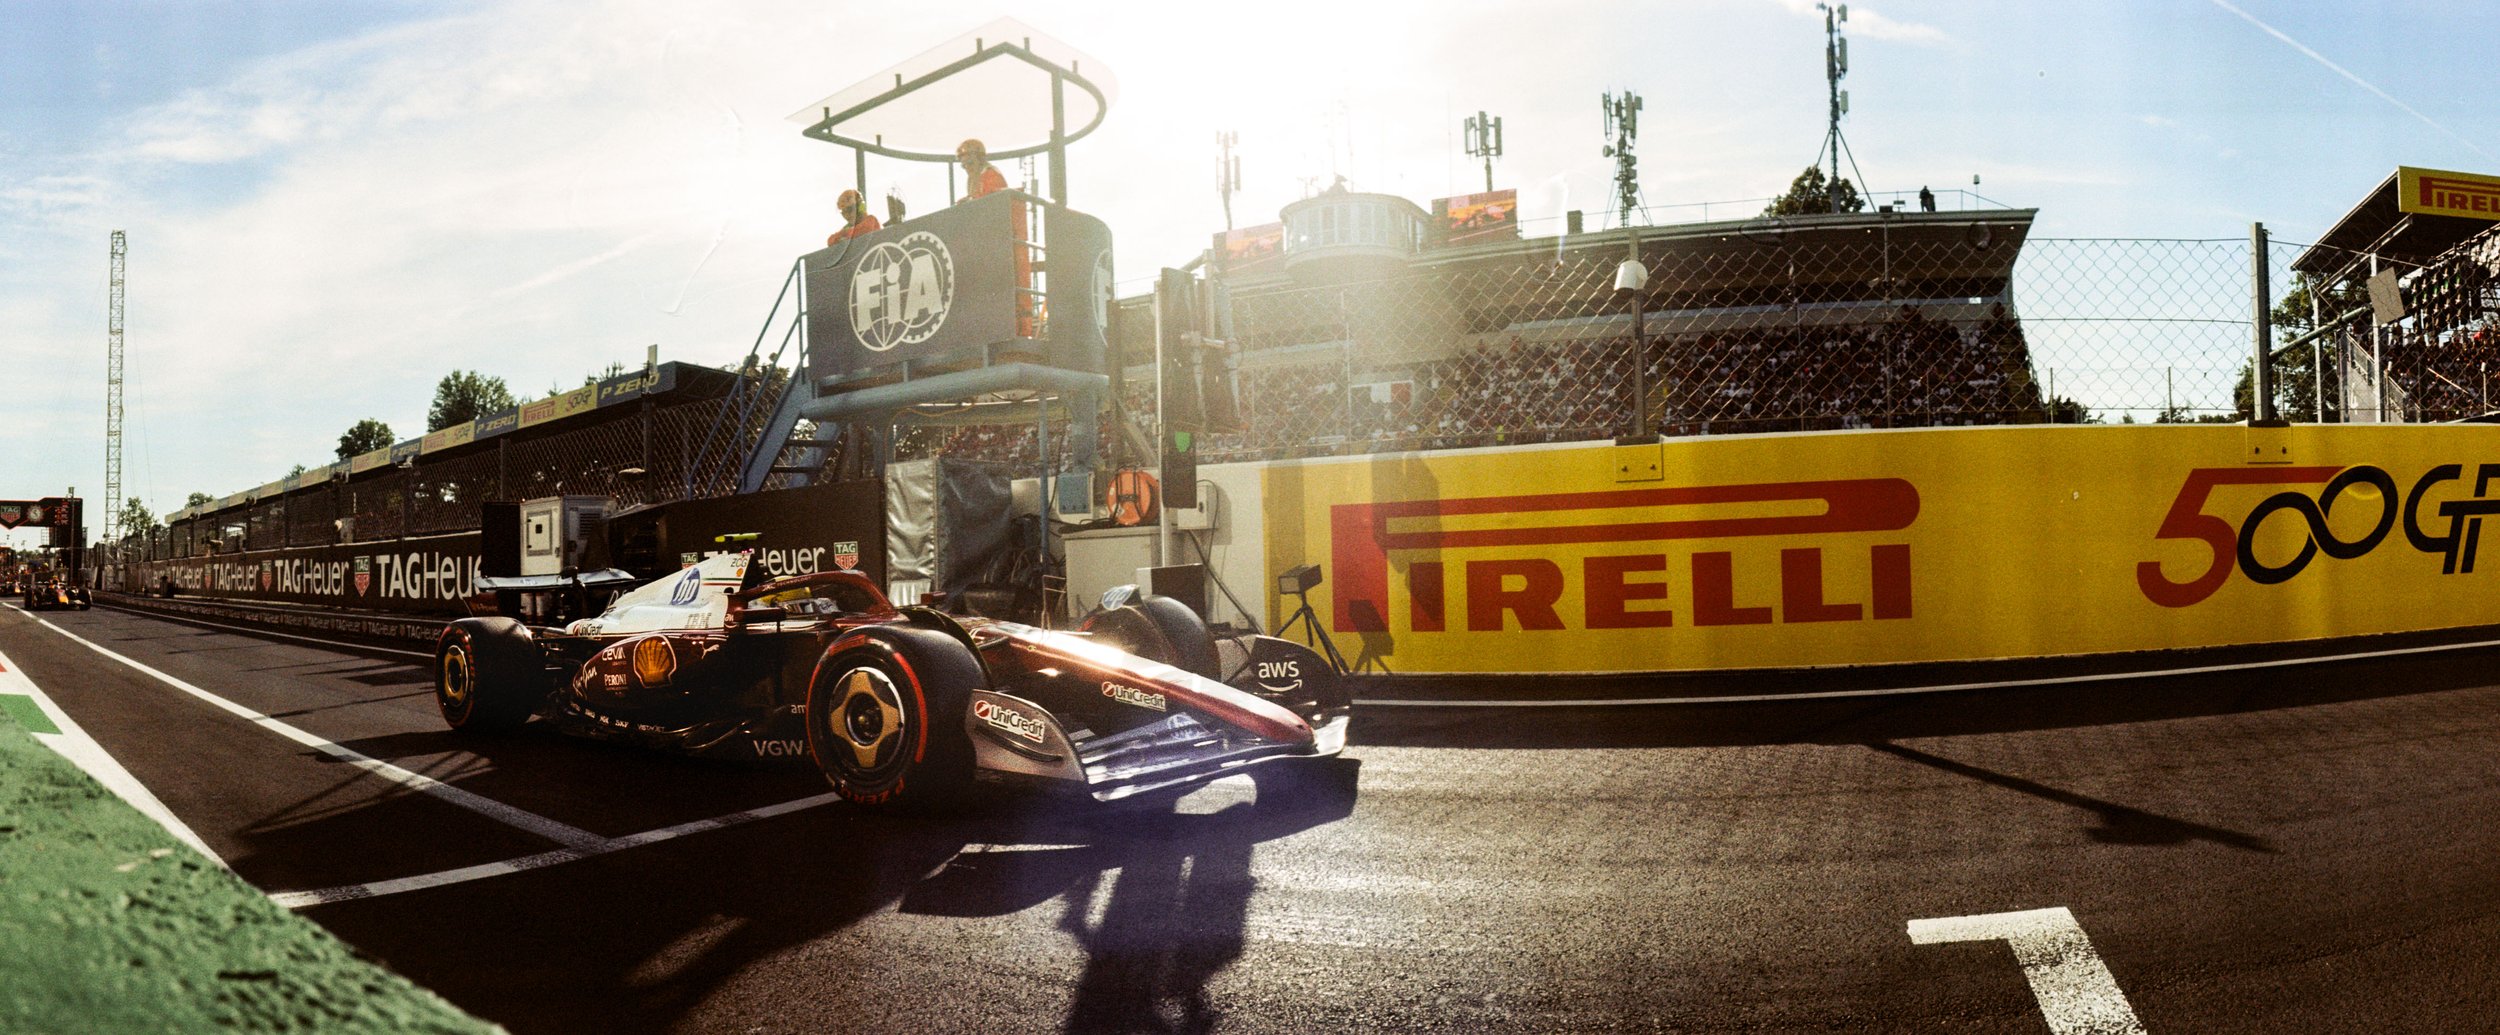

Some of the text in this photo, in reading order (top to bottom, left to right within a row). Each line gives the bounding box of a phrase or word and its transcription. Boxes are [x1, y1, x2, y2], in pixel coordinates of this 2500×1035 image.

[836, 544, 856, 553] TAG
[1331, 478, 1920, 632] PIRELLI
[682, 554, 698, 563] TAG
[673, 567, 700, 604] hp
[1258, 661, 1300, 678] aws
[604, 674, 627, 686] PERONI
[1115, 686, 1165, 709] UniCredit
[991, 706, 1044, 737] UniCredit
[753, 740, 804, 756] VGW
